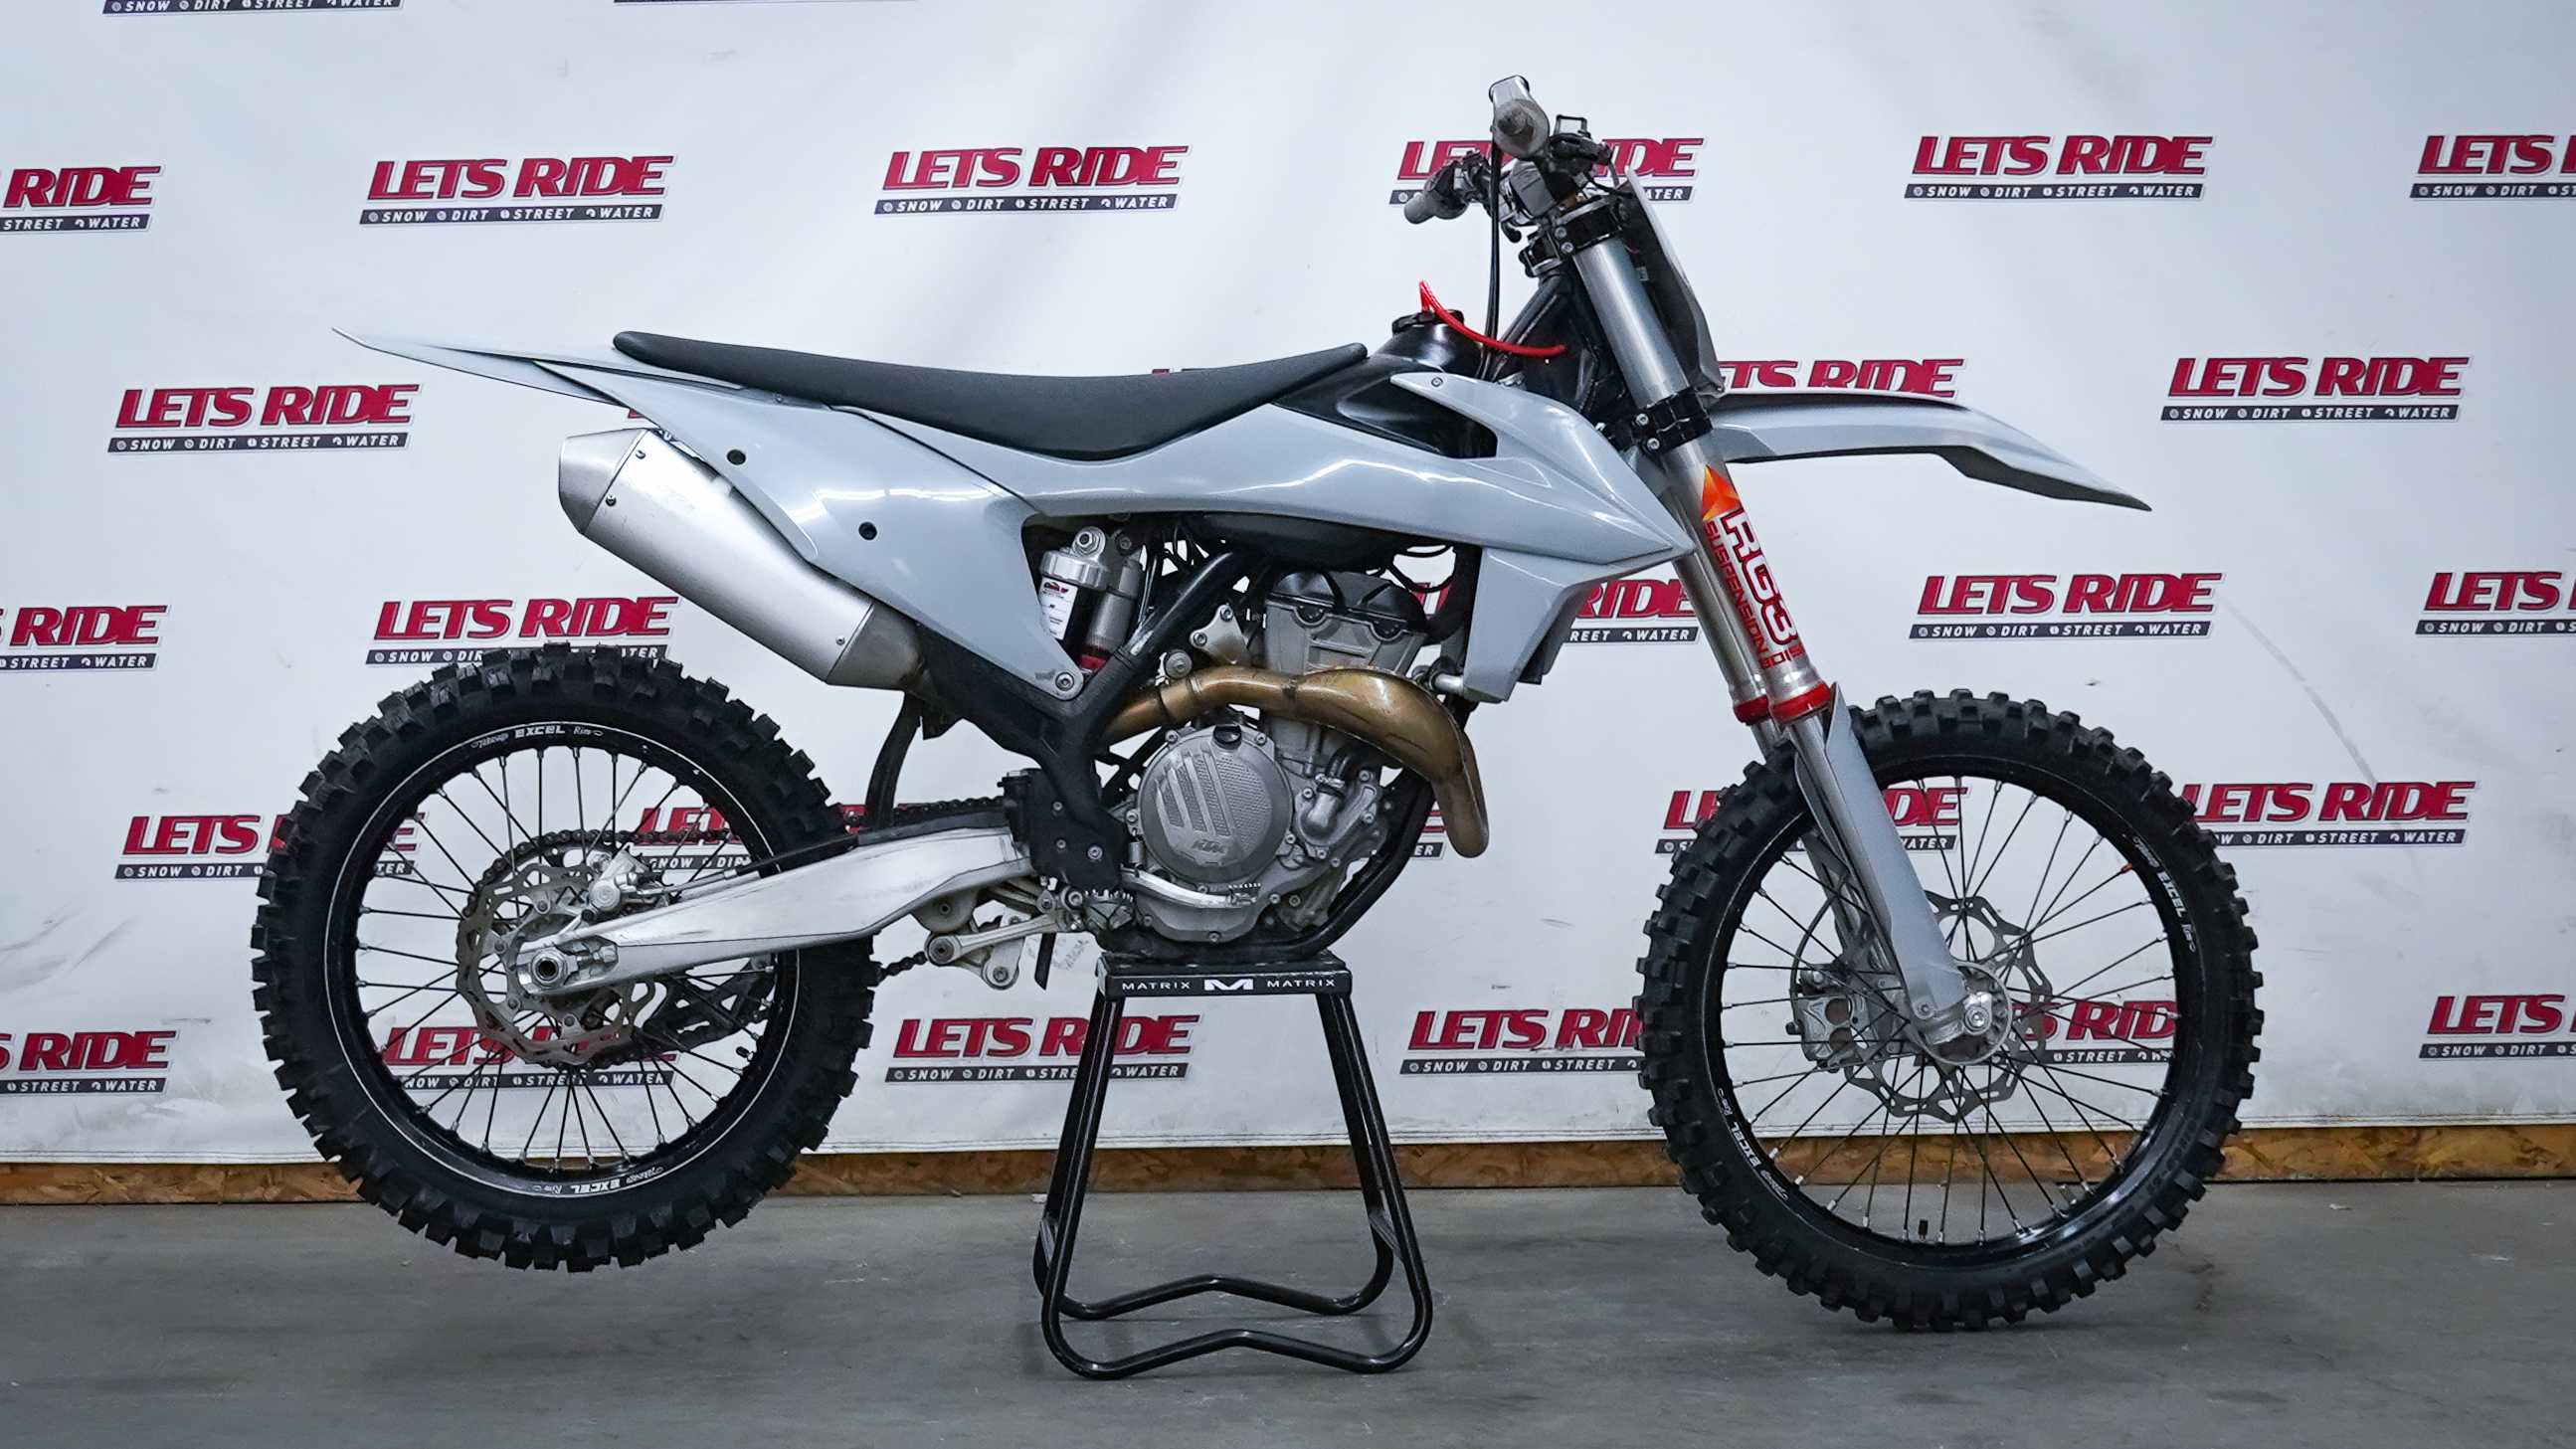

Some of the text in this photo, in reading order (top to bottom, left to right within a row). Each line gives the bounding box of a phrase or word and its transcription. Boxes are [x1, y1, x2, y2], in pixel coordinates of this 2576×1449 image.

[125, 0, 170, 11] SNOW
[194, 0, 230, 10] DIRT
[1913, 135, 2213, 176] LETS RIDE
[2417, 134, 2555, 174] LETS
[883, 145, 1188, 190] LETS RIDE
[367, 156, 673, 200] LETS RIDE
[3, 166, 161, 208] RIDE
[1645, 188, 1683, 199] ATER
[1927, 186, 2194, 197] SNOW DIRT STREET WATER
[2432, 185, 2537, 196] SNOW DIRT
[896, 196, 1168, 212] SNOW DIRT STREET WATER
[382, 206, 652, 222] SNOW DIRT STREET WATER
[4, 217, 140, 230] STREET WATER
[1807, 359, 1964, 397] RIDE
[2168, 356, 2470, 397] LETS RIDE
[115, 384, 419, 428] LETS RIDE
[2183, 407, 2450, 419] SNOW DIRT STREET WATER
[130, 435, 399, 451] SNOW DIRT STREET WATER
[1721, 508, 1798, 644] RG3
[1918, 573, 2222, 615] LETS RIDE
[2424, 571, 2562, 611] LETS
[10, 605, 167, 646] RIDE
[374, 597, 678, 639] LETS RIDE
[1569, 629, 1689, 640] REET WATER
[1932, 623, 2201, 636] SNOW DIRT STREET WATER
[2439, 622, 2545, 633] SNOW DIRT
[10, 655, 146, 668] STREET WATER
[389, 649, 482, 662] SNOW DIR
[514, 725, 565, 738] EXCEL
[1885, 787, 1968, 825] DE
[2317, 782, 2476, 821] RIDE
[122, 815, 261, 855] LETS
[2257, 831, 2457, 843] DIRT STREET WATER
[137, 864, 243, 877] SNOW DIRT
[377, 863, 405, 873] TER
[1267, 979, 1336, 988] MATRIX
[2066, 1000, 2176, 1040] RID
[2427, 995, 2565, 1034] LETS
[893, 1014, 1200, 1058] LETS RDE
[1408, 1009, 1549, 1050] LETS
[19, 1030, 177, 1071] RIDE
[2066, 1051, 2126, 1062] STREET
[2442, 1045, 2546, 1056] SNOW DIRT
[908, 1066, 1179, 1080] SNOW DIRT STRE WATER
[1423, 1059, 1615, 1072] SNOW DIRT STREET
[20, 1080, 157, 1092] STREET WATER
[1732, 1122, 1761, 1167] EXCEL
